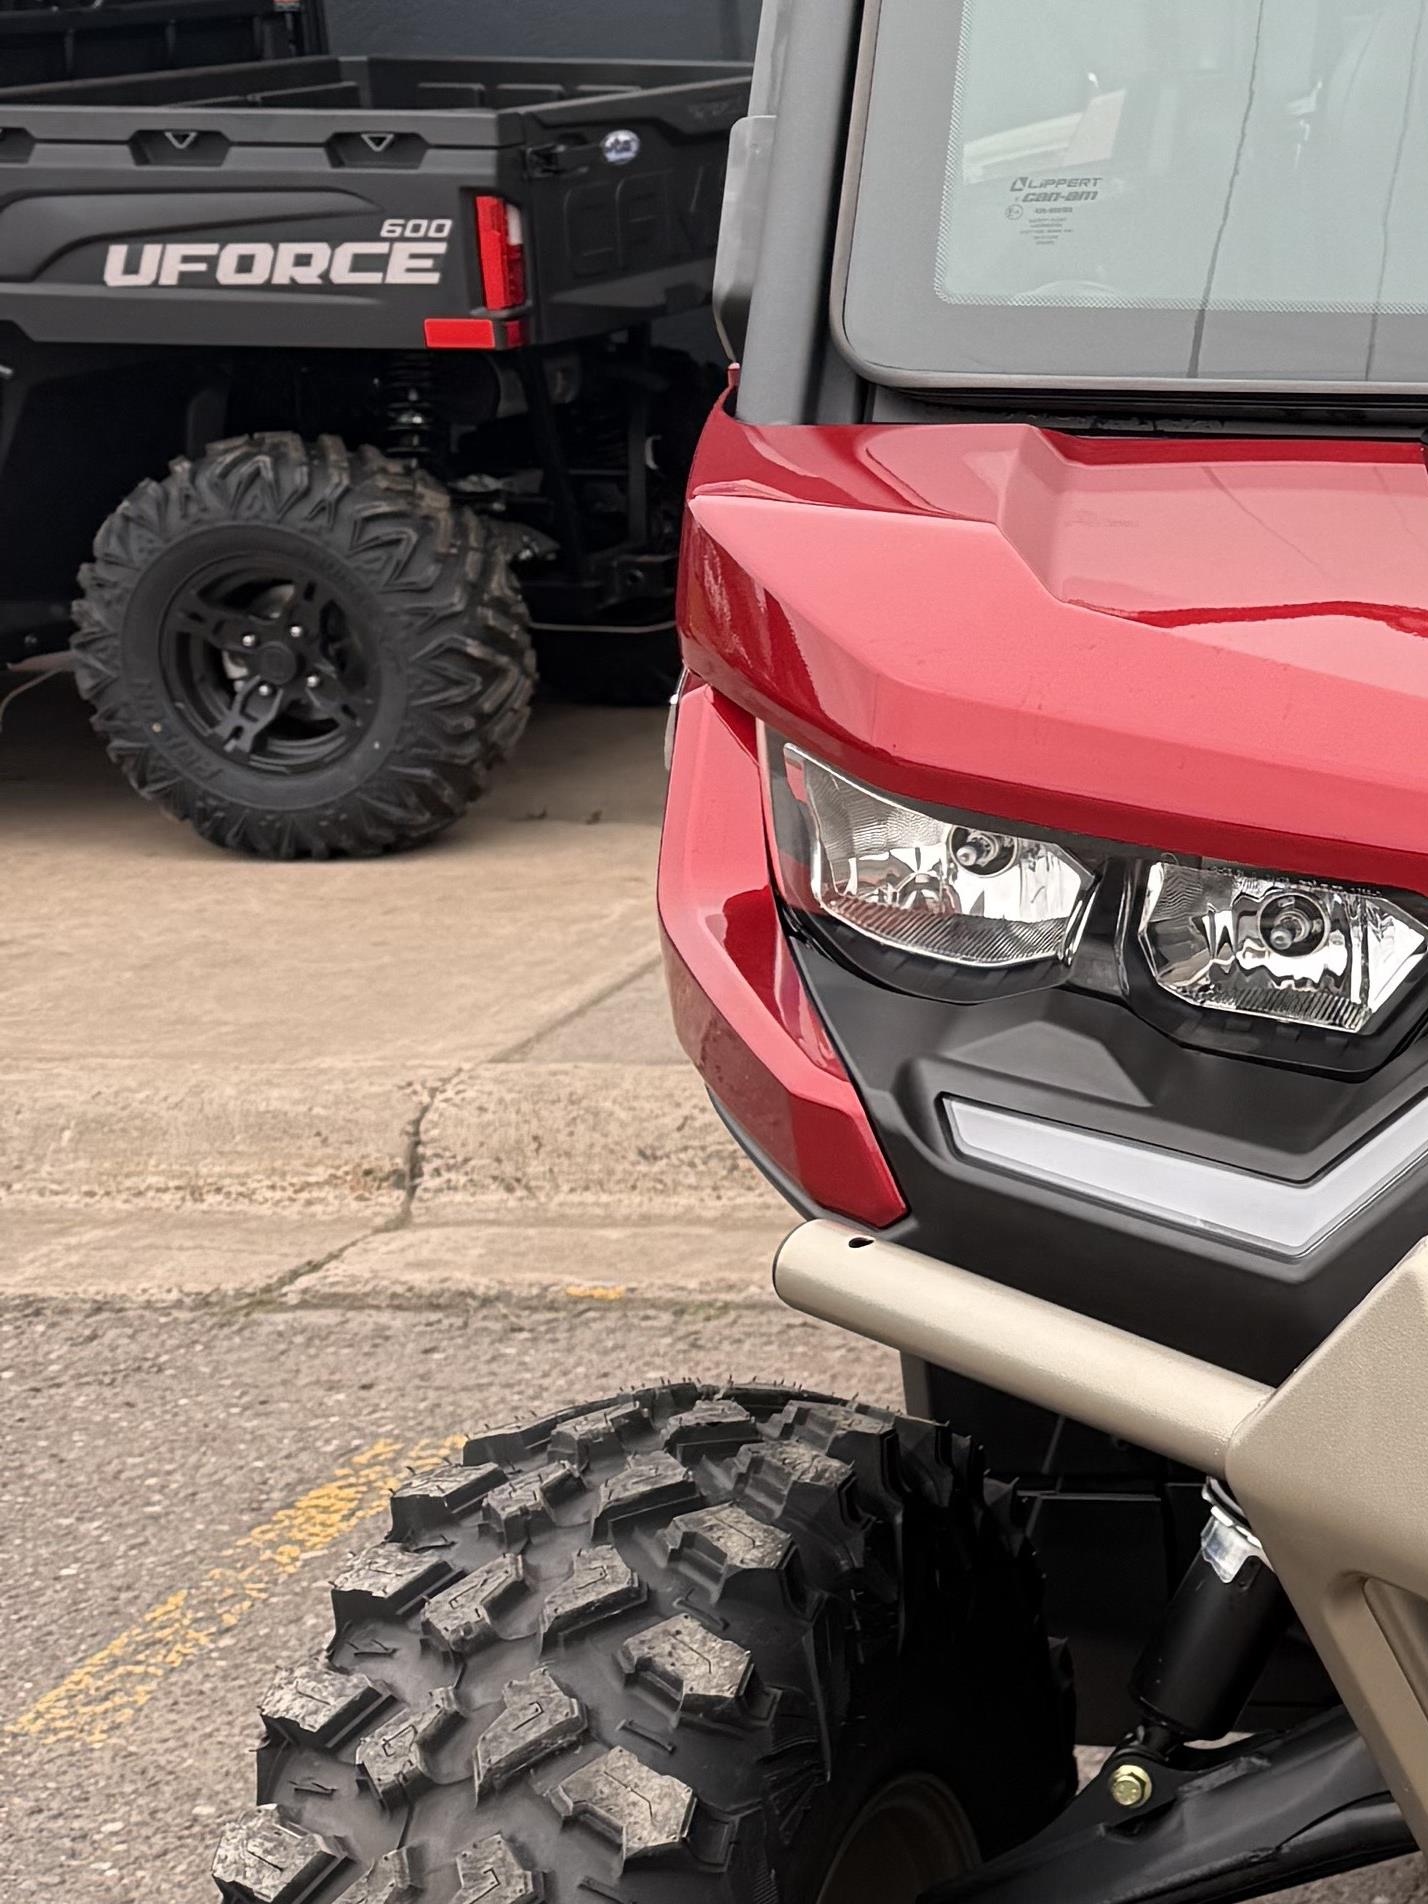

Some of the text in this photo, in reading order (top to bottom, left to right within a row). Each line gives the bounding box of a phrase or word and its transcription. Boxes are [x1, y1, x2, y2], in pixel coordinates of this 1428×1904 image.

[1027, 178, 1104, 189] LIPPERT
[380, 218, 452, 238] 600
[103, 242, 448, 287] UFORCE
